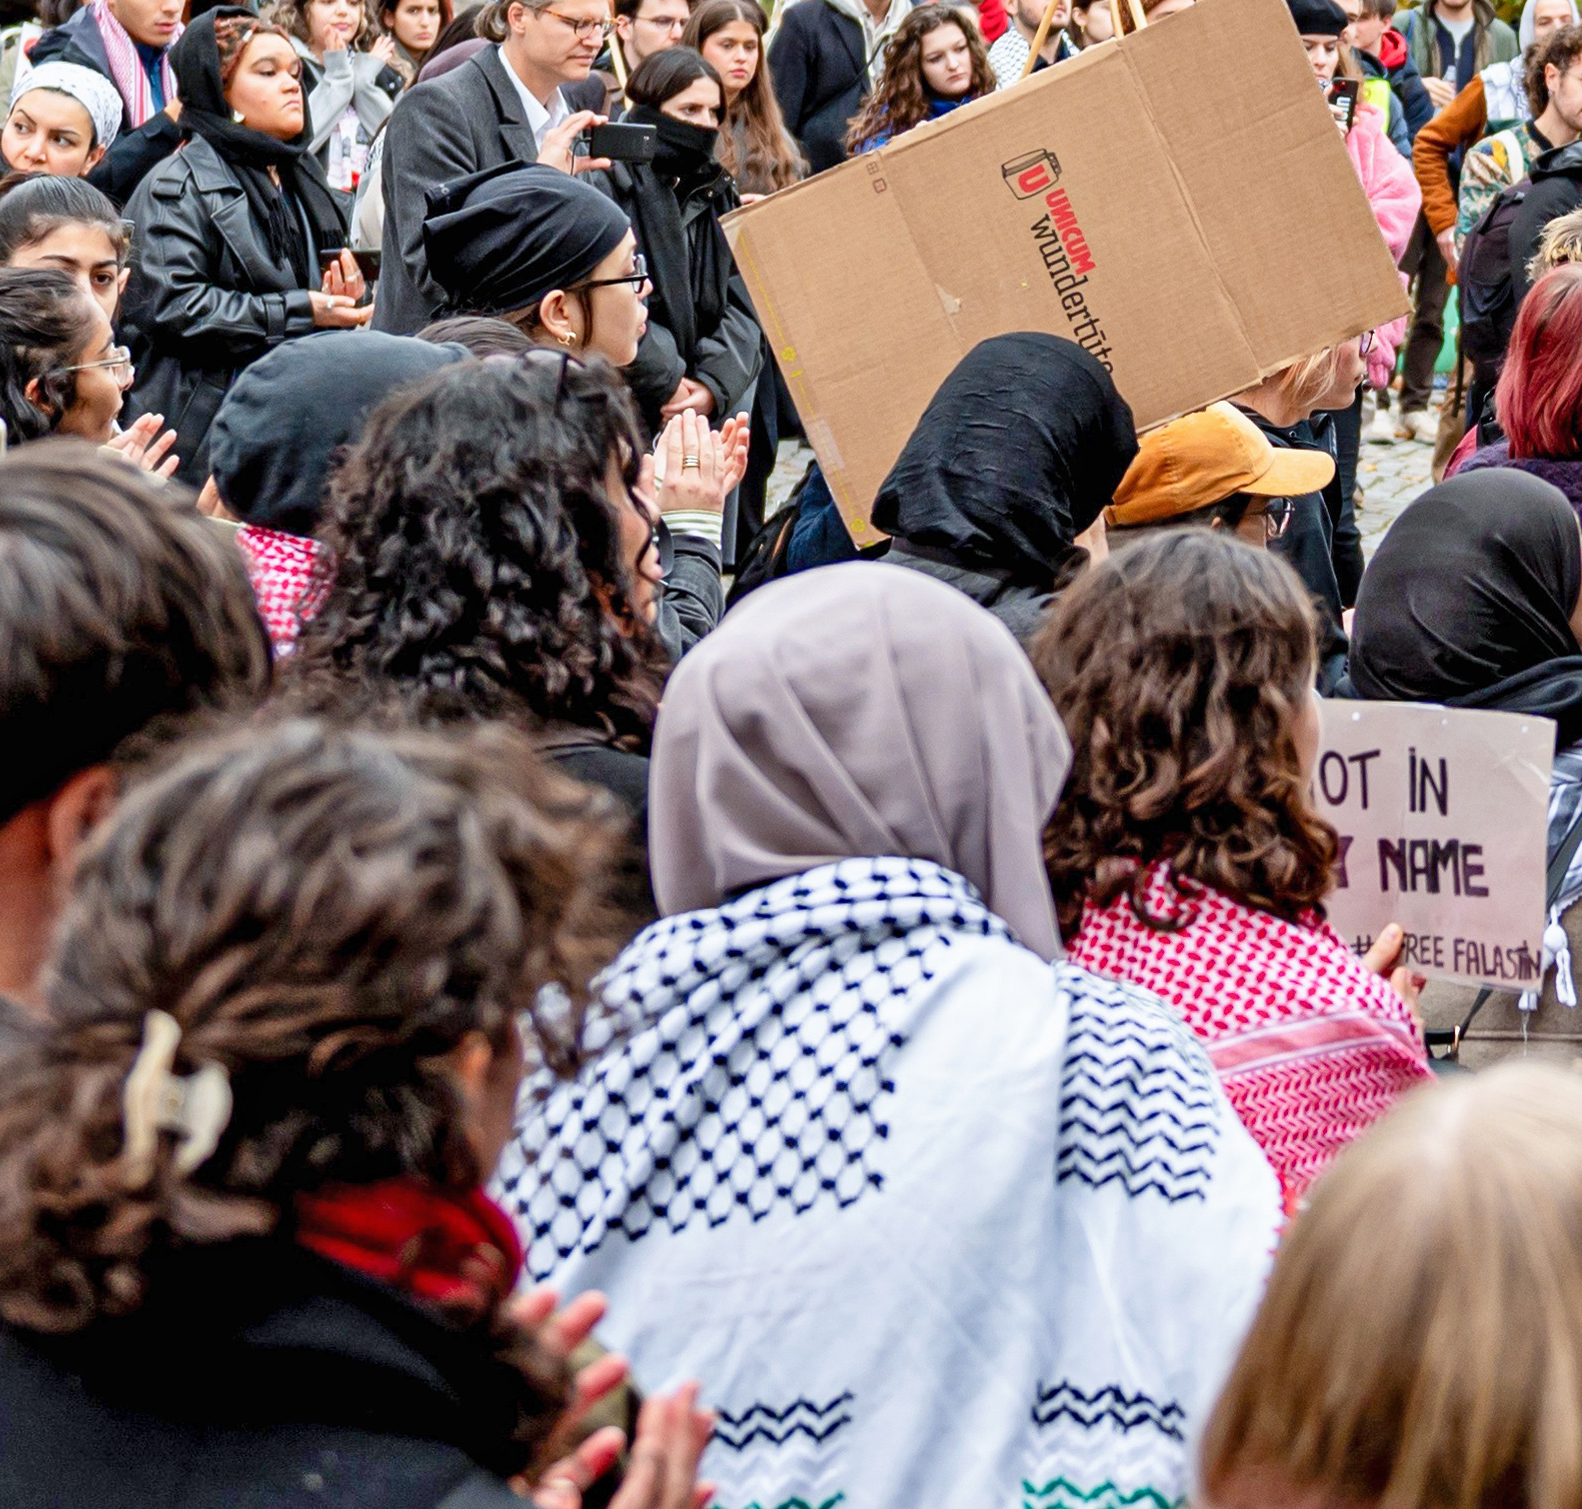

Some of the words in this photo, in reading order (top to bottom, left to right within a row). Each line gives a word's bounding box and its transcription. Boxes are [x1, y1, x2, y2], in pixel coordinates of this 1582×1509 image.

[1045, 187, 1097, 276] UNICUM
[1310, 748, 1382, 812] OT
[1377, 837, 1490, 897] NAME
